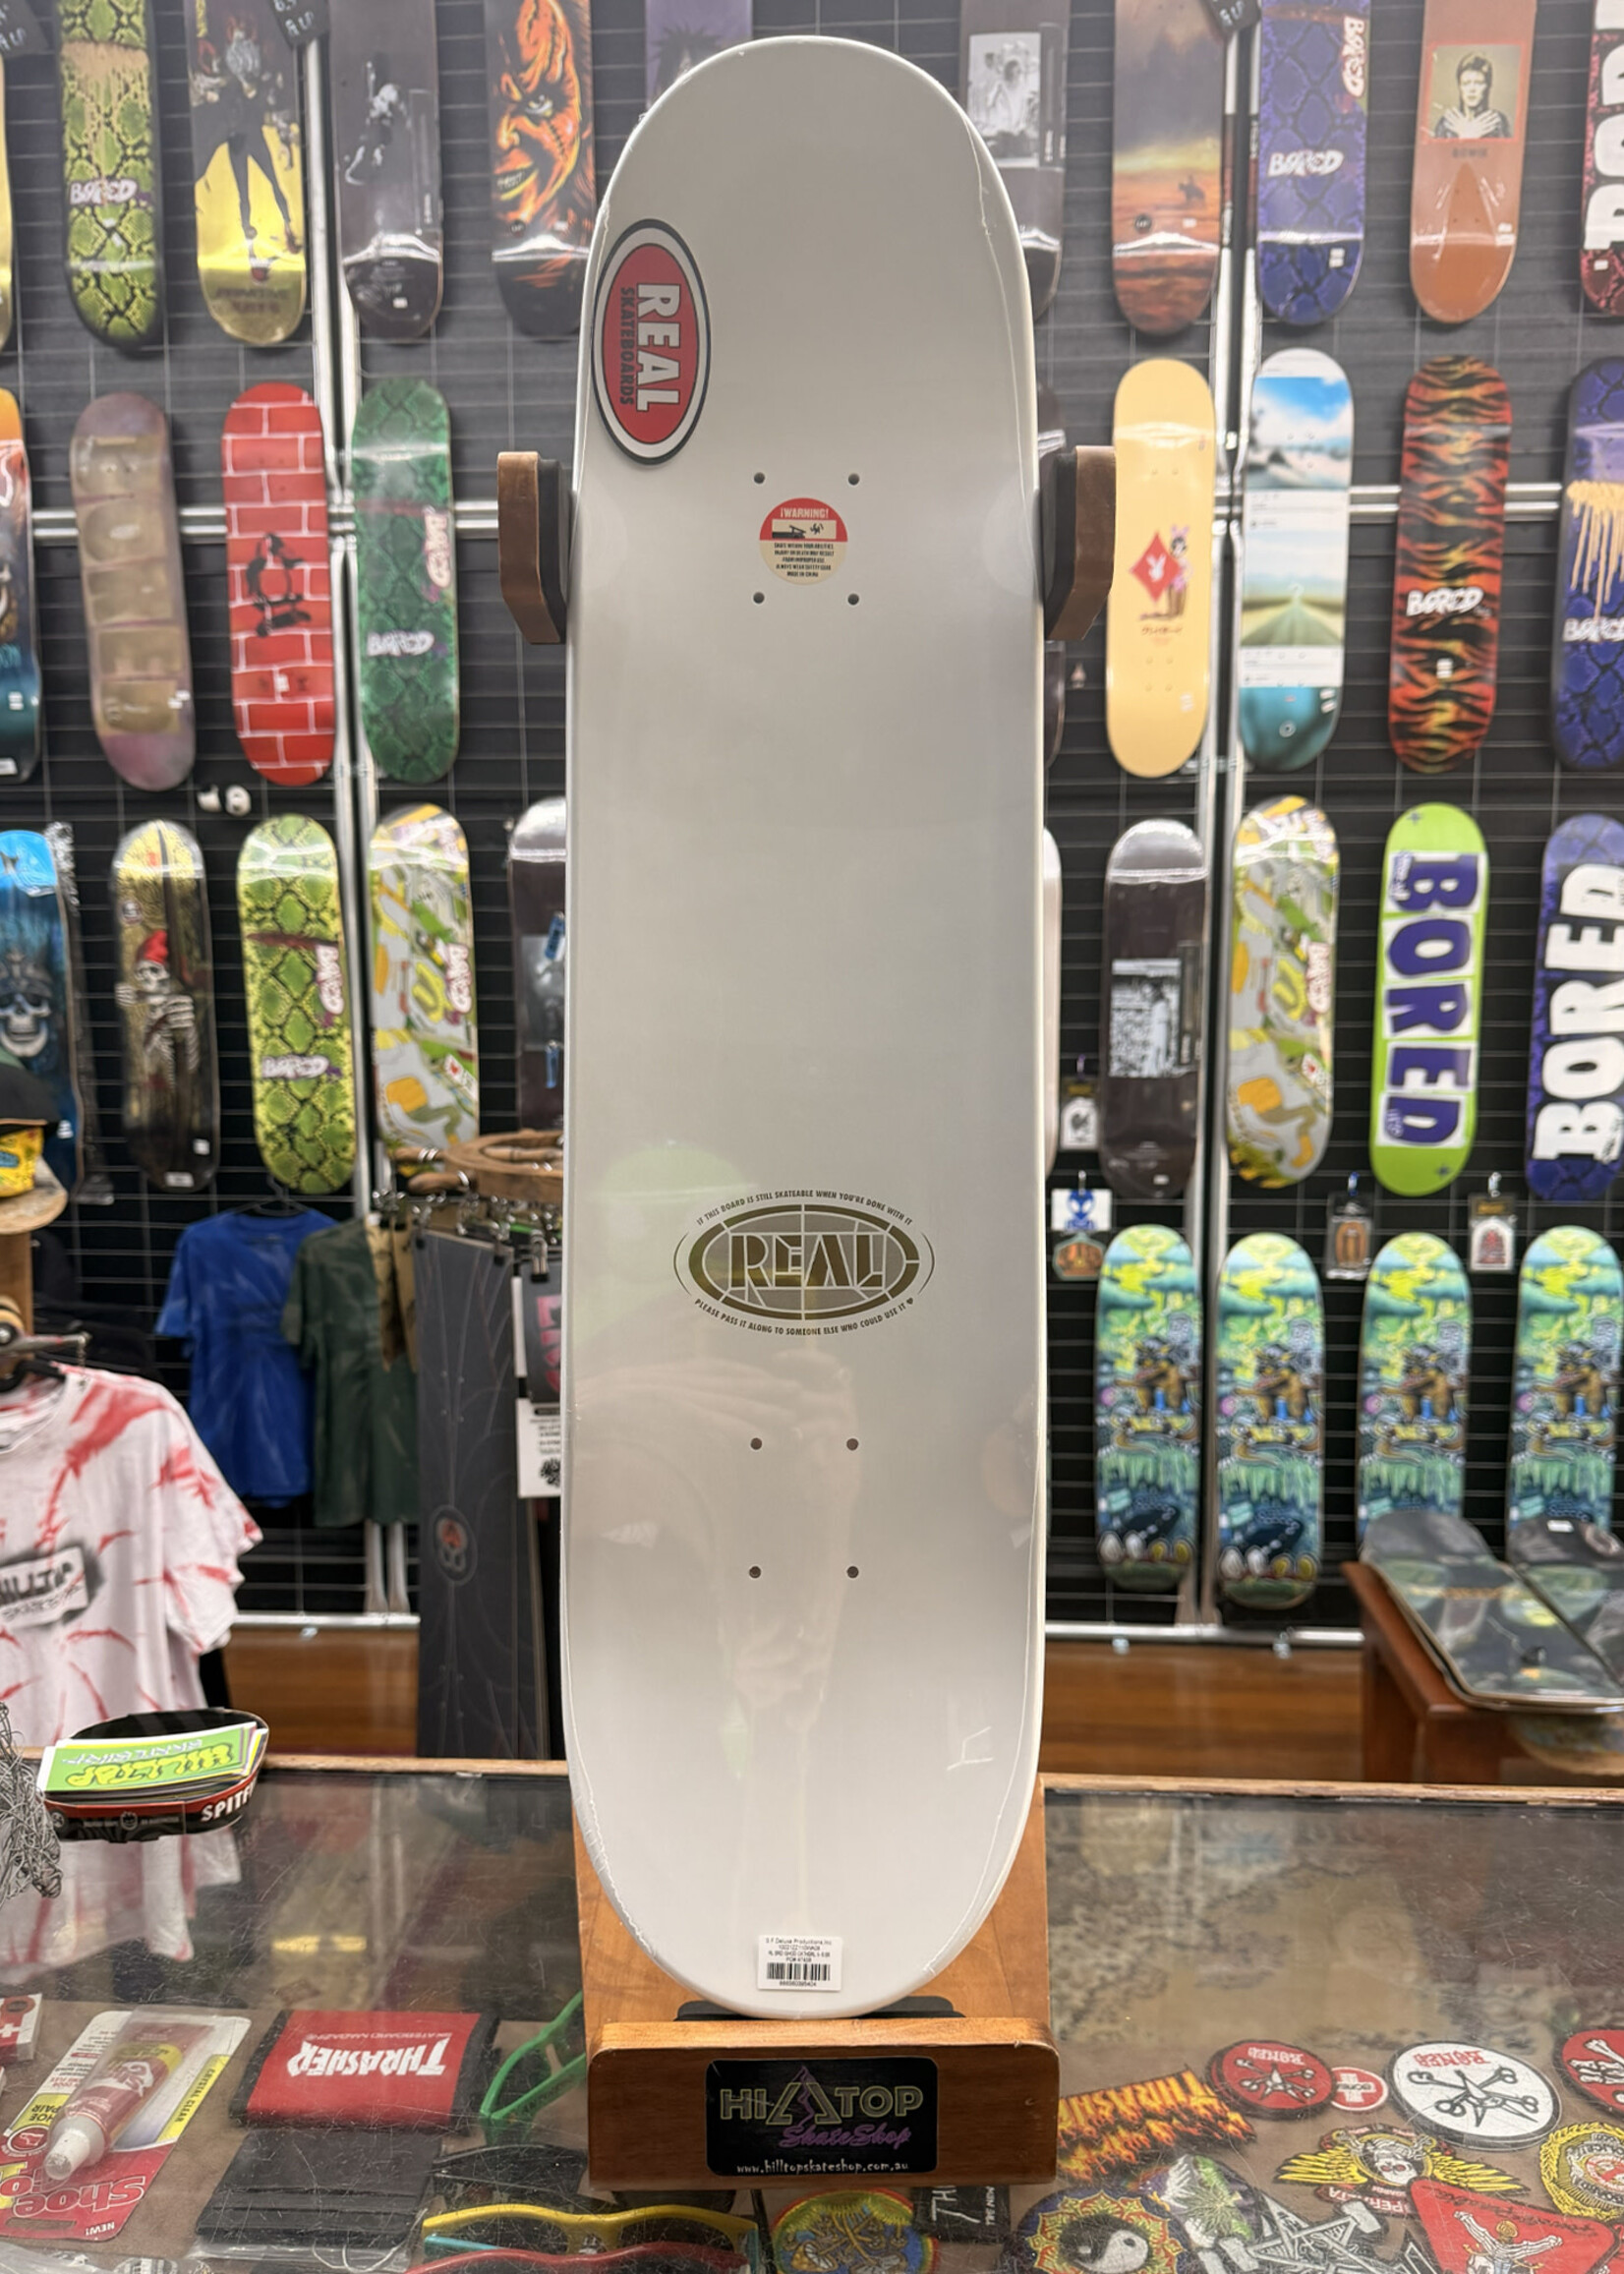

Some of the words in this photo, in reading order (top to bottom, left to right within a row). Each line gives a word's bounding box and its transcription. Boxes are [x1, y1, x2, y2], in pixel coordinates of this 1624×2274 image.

[619, 287, 635, 406] SKATEBOARDS
[636, 283, 681, 413] REAL
[1384, 853, 1479, 1147] BORED
[1532, 863, 1624, 1161] BORED
[704, 1207, 720, 1220] THIS
[721, 1198, 745, 1212] BOARD
[756, 1193, 773, 1201] STILL
[775, 1190, 813, 1199] SKATEABLE
[816, 1190, 837, 1198] WHEN
[840, 1193, 865, 1204] YOU'RE
[866, 1198, 886, 1211] DONE
[887, 1206, 904, 1221] WITH
[729, 1234, 884, 1288] REAL
[695, 1298, 719, 1317] PLEASE
[721, 1312, 738, 1325] PASS
[748, 1322, 773, 1333] ALONG
[823, 1325, 839, 1334] ELSE
[841, 1322, 857, 1332] WHO
[860, 1314, 883, 1328] COULD
[884, 1308, 898, 1319] USE
[898, 1303, 906, 1312] IT
[201, 1779, 256, 1821] SPITF
[286, 2036, 451, 2077] THRASHER
[737, 2158, 909, 2175] www.hilltopskateshop.com.au
[13, 2175, 145, 2218] Shoe
[85, 2221, 115, 2237] NEW!
